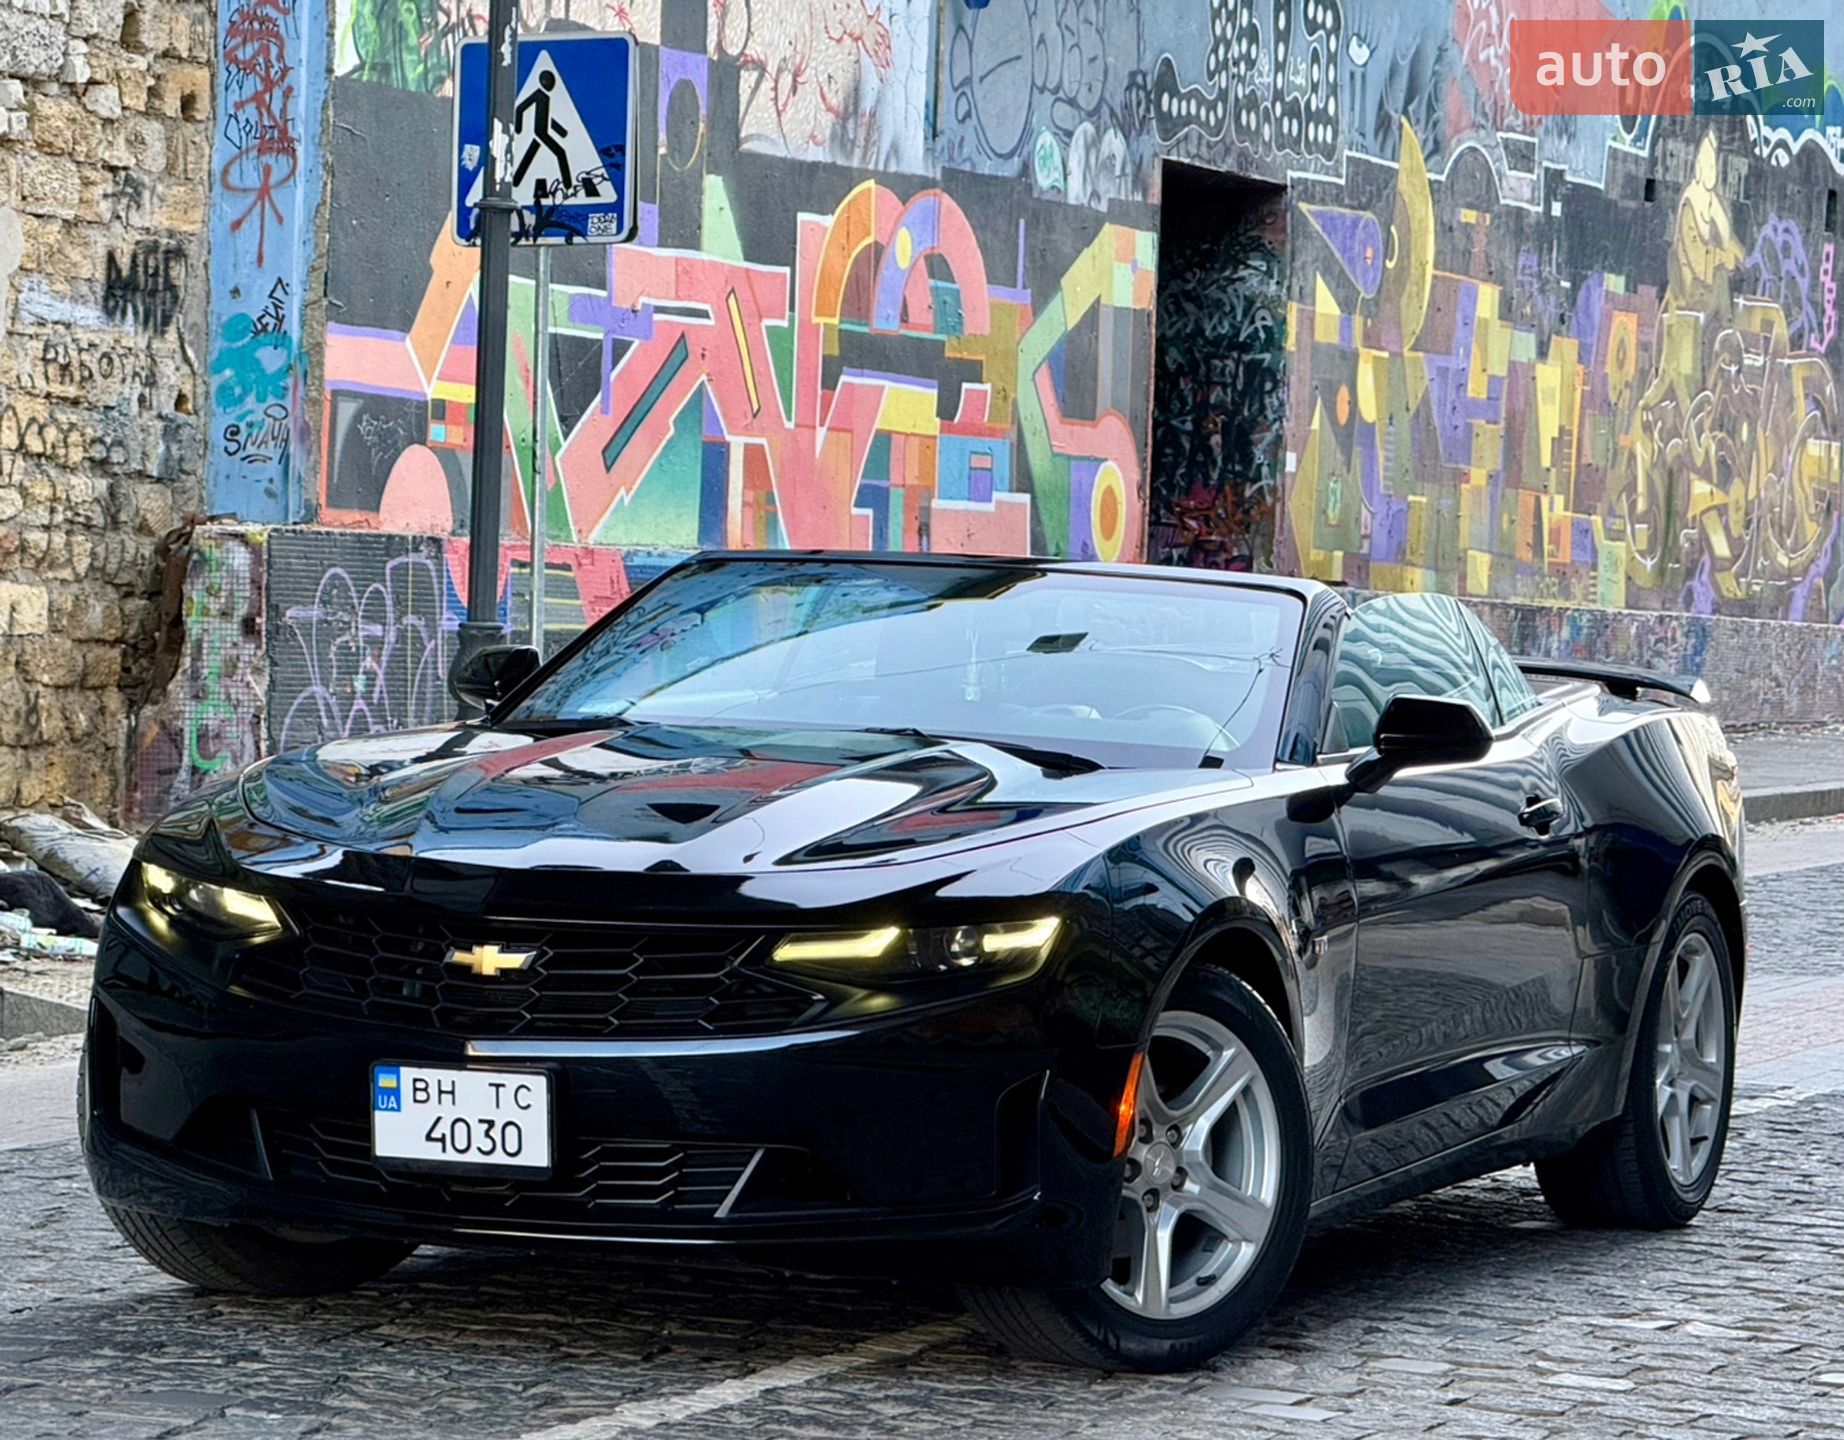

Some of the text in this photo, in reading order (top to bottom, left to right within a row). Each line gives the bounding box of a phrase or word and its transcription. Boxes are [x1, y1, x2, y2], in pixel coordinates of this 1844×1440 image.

[378, 1095, 398, 1110] UA
[412, 1077, 532, 1110] BH TC
[425, 1116, 523, 1158] 4030
